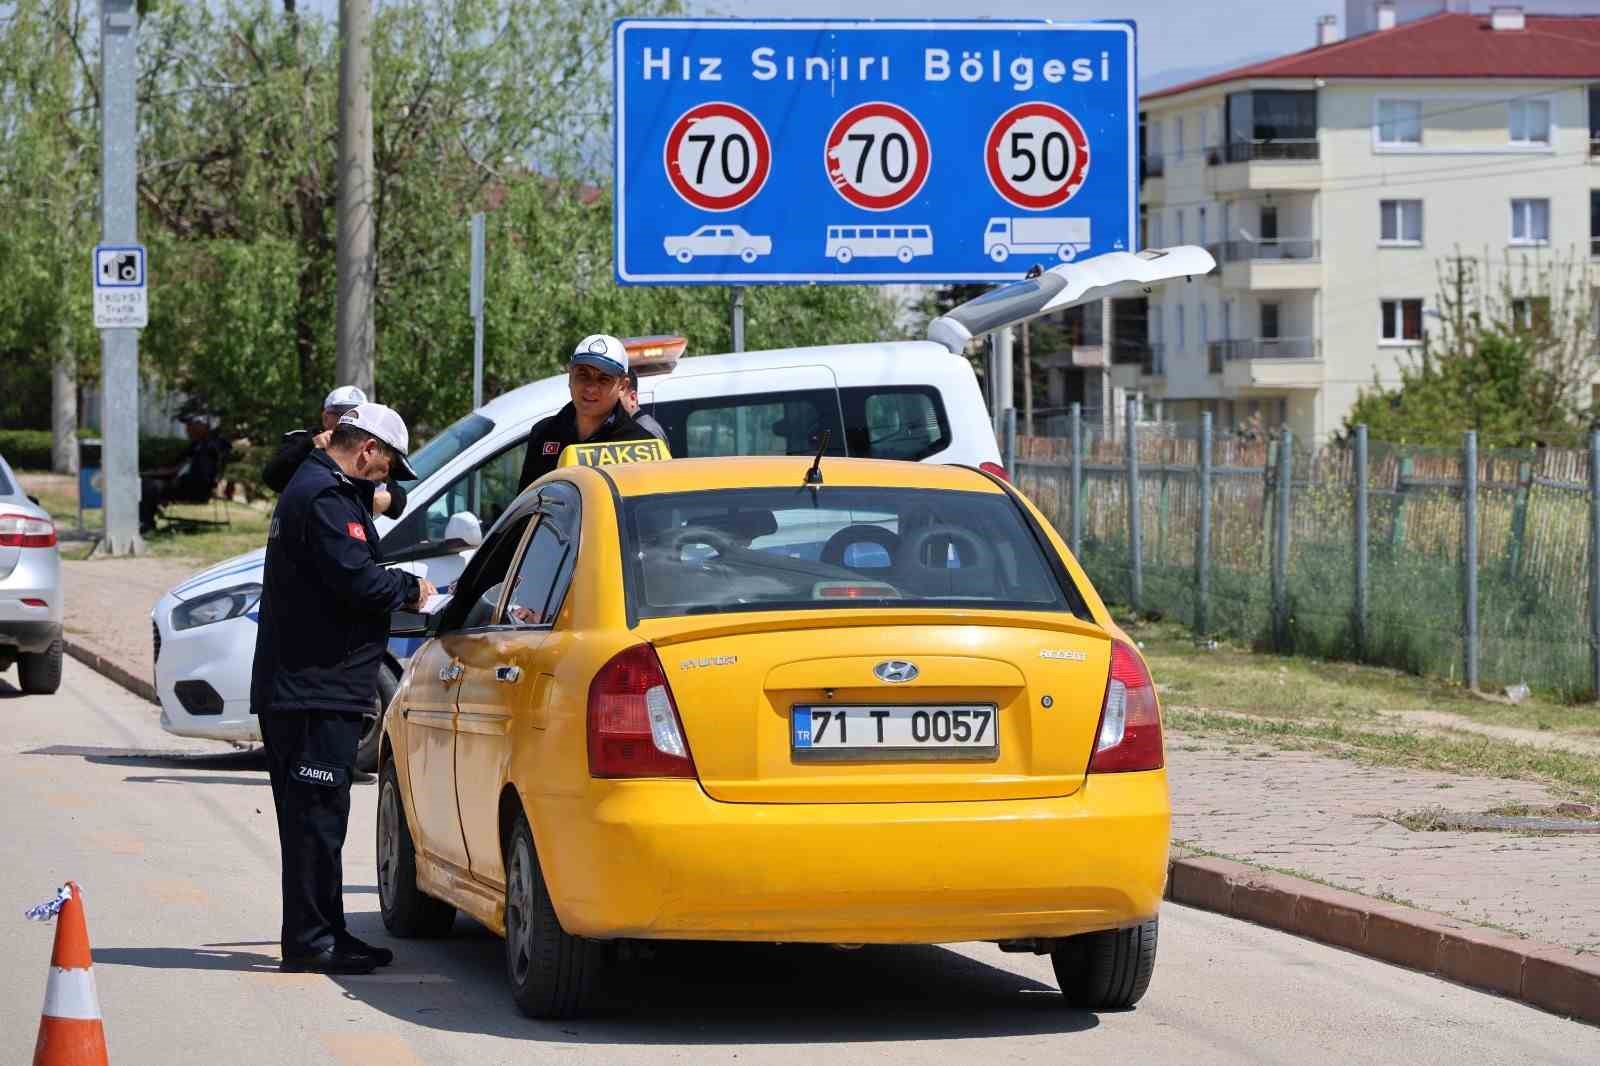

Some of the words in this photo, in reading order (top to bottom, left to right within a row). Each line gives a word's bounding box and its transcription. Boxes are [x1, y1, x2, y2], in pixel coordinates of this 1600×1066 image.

[643, 47, 722, 81] Hız
[752, 47, 889, 82] Sınırı
[924, 48, 1109, 92] Bölgesi
[688, 133, 750, 185] 70
[848, 132, 909, 183] 70
[1010, 131, 1070, 182] 50
[797, 730, 810, 741] TR
[812, 710, 847, 744] 71
[869, 710, 890, 744] T
[911, 710, 992, 743] 0057
[299, 766, 334, 782] ZABITA
